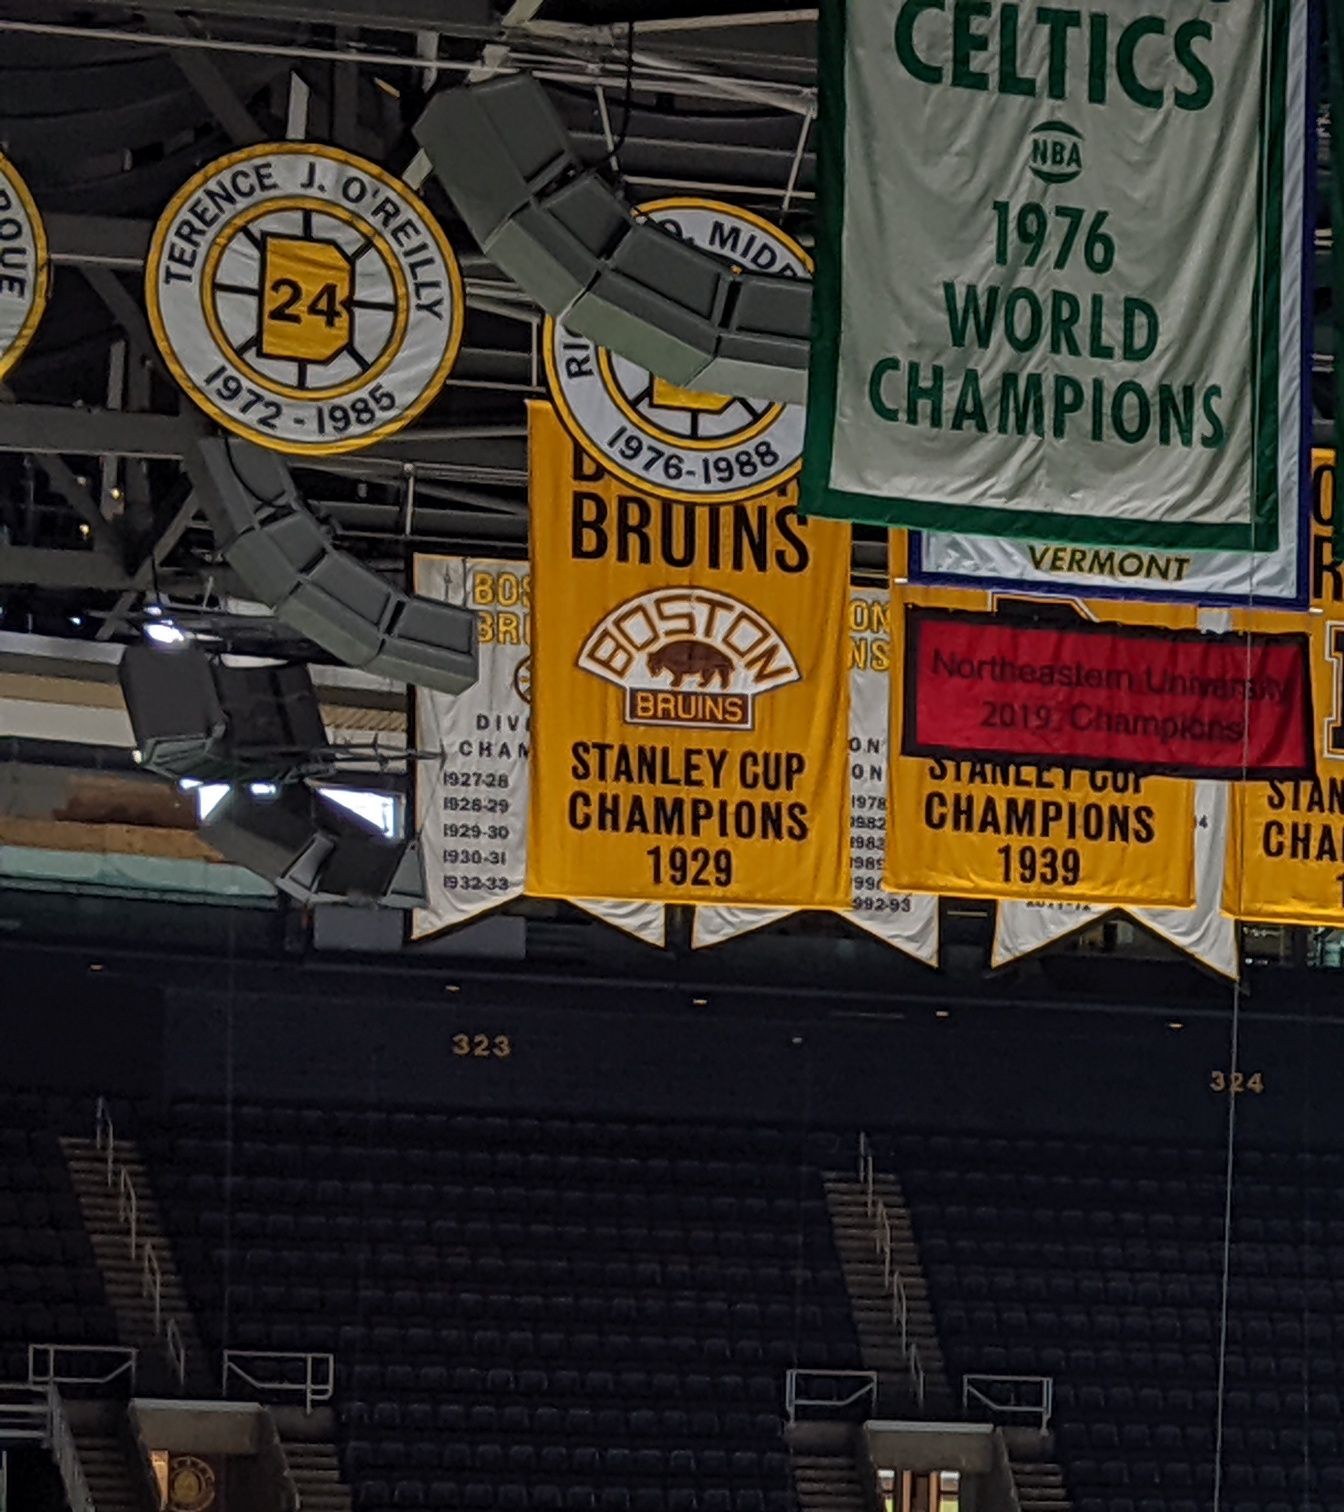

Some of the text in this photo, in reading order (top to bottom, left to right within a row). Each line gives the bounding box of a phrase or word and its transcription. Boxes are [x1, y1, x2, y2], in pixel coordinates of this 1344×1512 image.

[894, 0, 1216, 110] CELTICS
[1030, 137, 1083, 169] NBA
[164, 162, 278, 286] TERENCE
[341, 177, 445, 321] O'REILLY
[991, 200, 1116, 275] 1976
[267, 278, 344, 328] 24
[943, 280, 1160, 363] WORLD
[203, 365, 397, 435] 1972 1985
[868, 356, 1225, 450] CHAMPIONS
[606, 426, 781, 484] 1976-1988
[571, 490, 812, 573] BRUINS
[1027, 544, 1190, 582] VERMONT
[588, 592, 793, 684] BOSTON
[635, 693, 744, 723] BRUINS
[980, 702, 1053, 732] 2019
[570, 741, 728, 790] STANLEY
[739, 750, 806, 793] CUP
[568, 792, 810, 842] CHAMPIONS
[924, 793, 1155, 844] CHAMPIONS
[646, 846, 735, 888] 1929
[998, 844, 1082, 887] 1939
[451, 1033, 512, 1057] 323
[1209, 1069, 1265, 1094] 324
